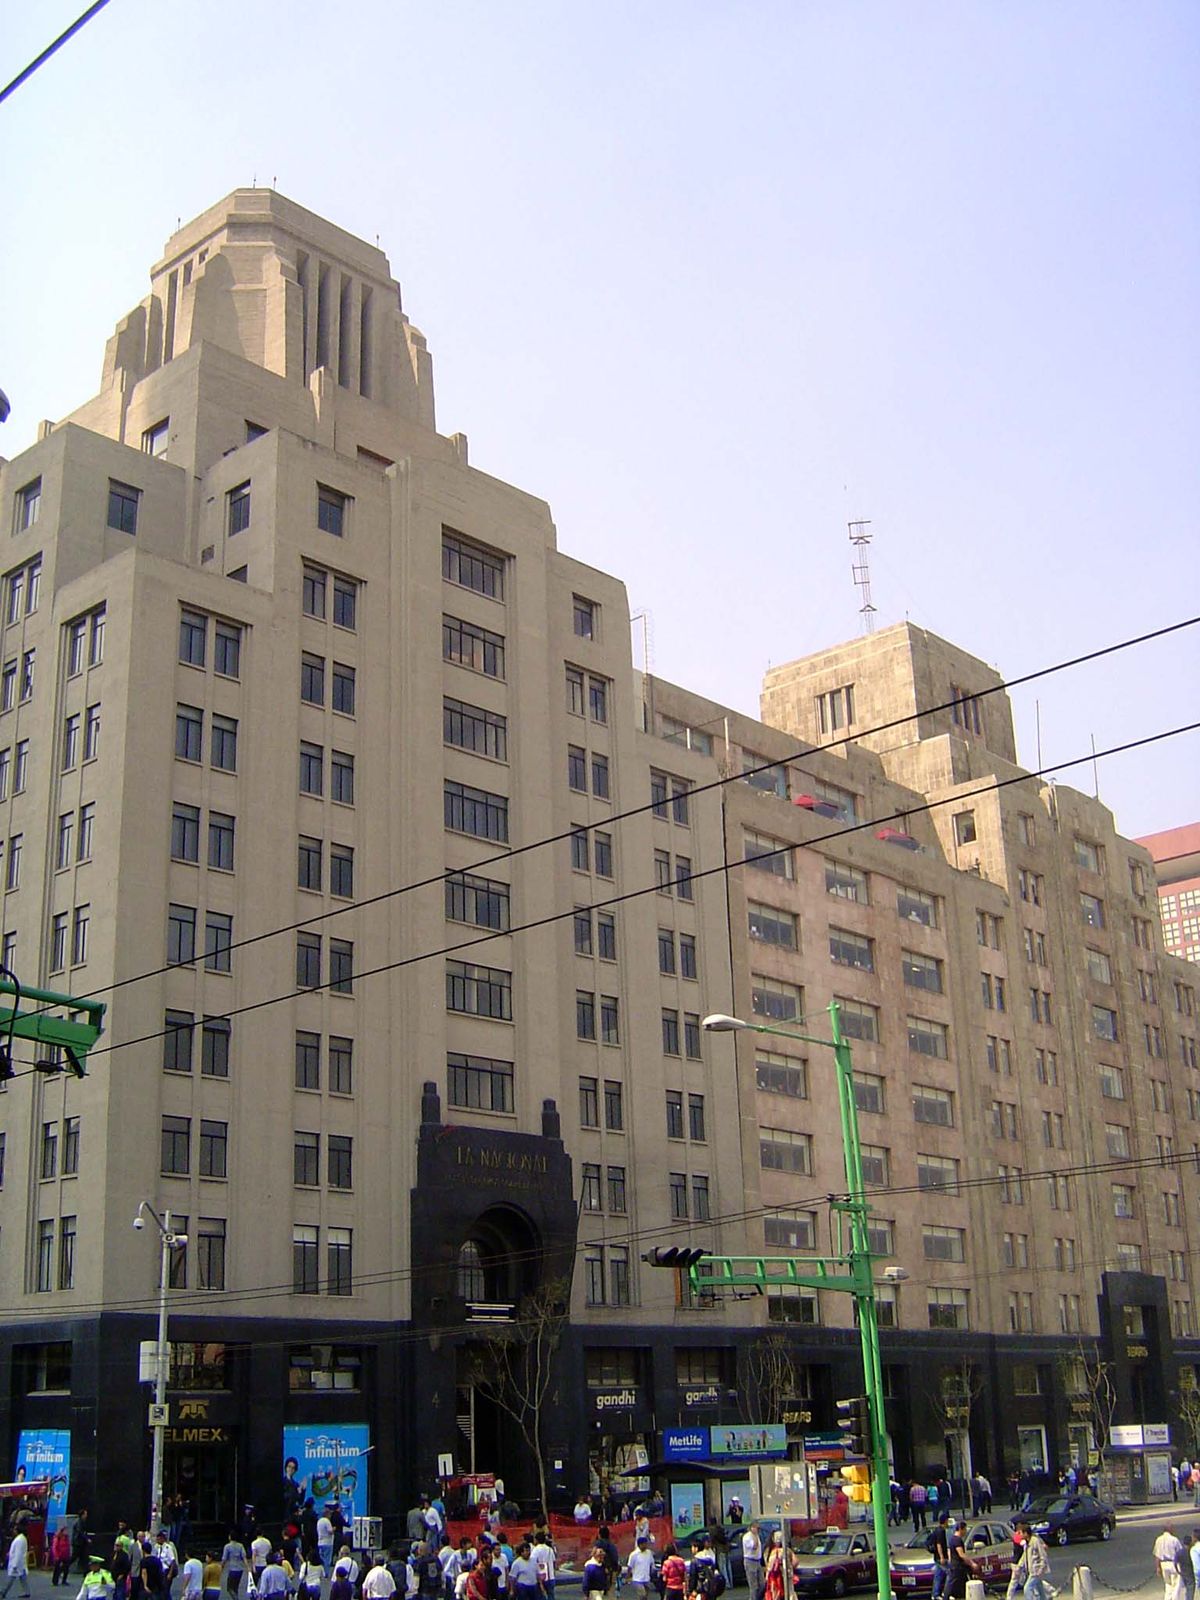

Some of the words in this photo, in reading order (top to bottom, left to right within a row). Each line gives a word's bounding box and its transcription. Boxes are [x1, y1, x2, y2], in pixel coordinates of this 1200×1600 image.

[596, 1390, 636, 1410] gandhi
[782, 1411, 812, 1424] SEARS
[669, 1434, 703, 1447] MetLife
[304, 1443, 360, 1459] infinitum
